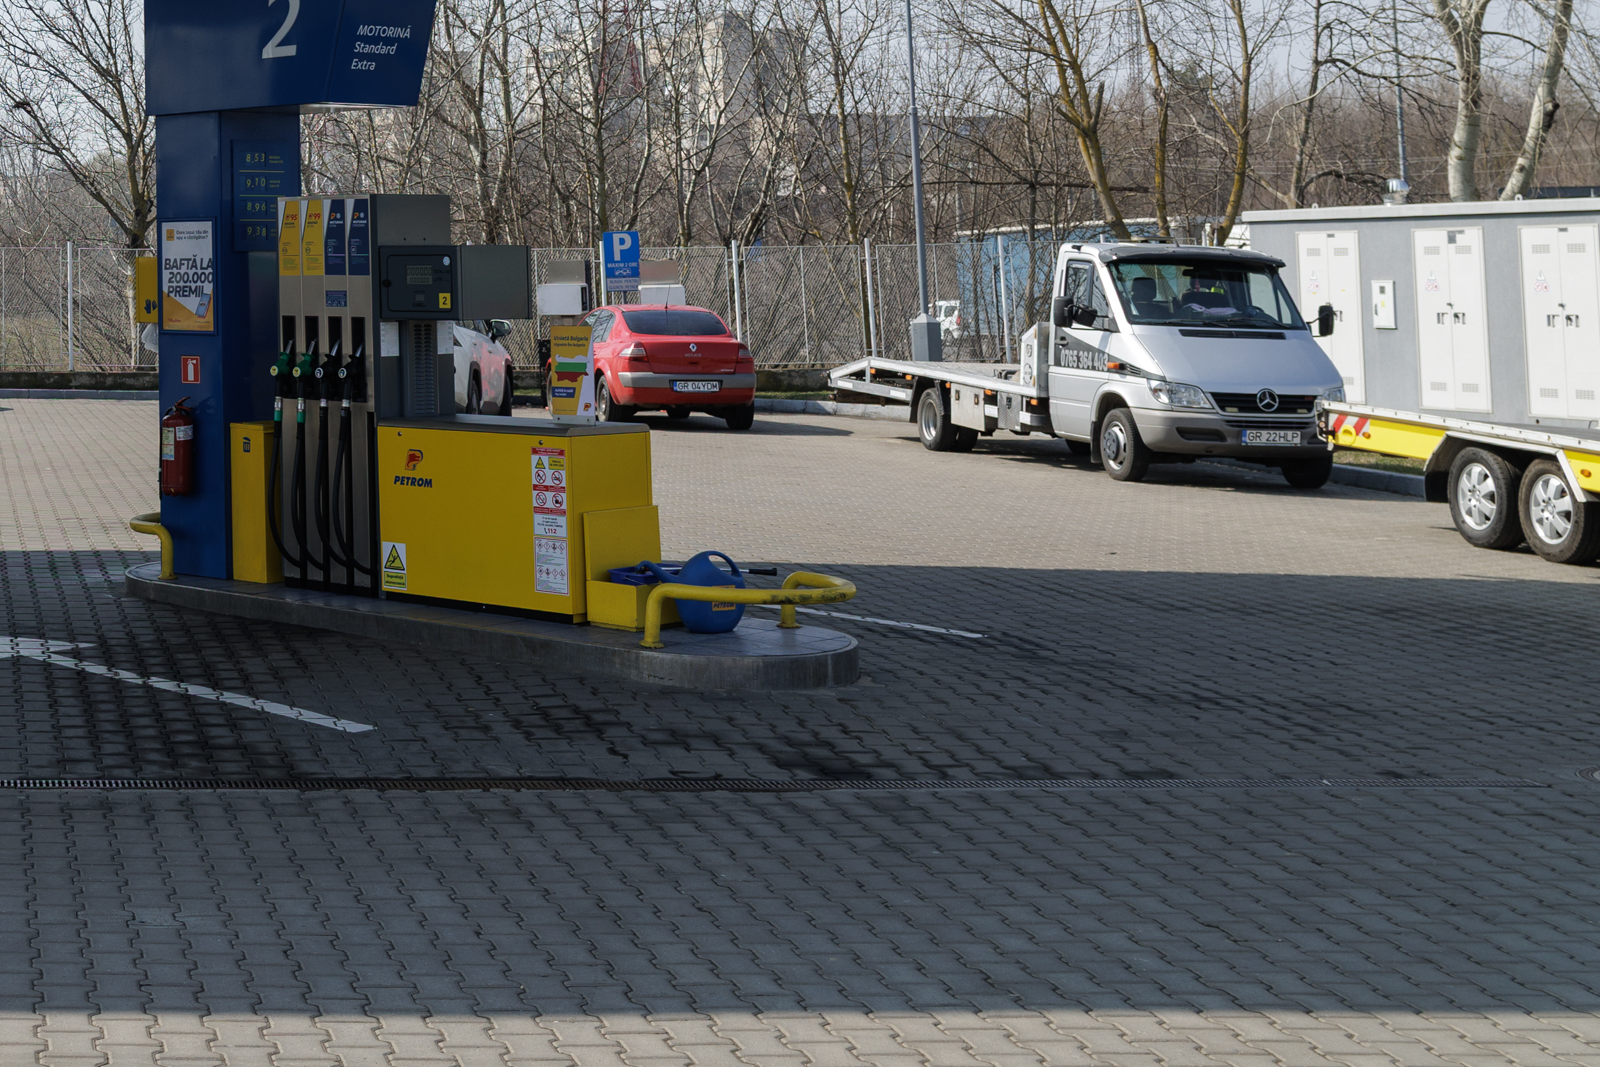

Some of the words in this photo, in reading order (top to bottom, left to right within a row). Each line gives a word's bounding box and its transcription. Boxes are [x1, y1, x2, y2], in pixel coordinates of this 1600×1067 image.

[357, 25, 412, 39] MOTORINĂ
[354, 41, 398, 55] Standard
[351, 59, 376, 71] Extra
[246, 153, 266, 164] 8.53
[246, 178, 266, 188] 9.10
[247, 202, 266, 212] 8.96
[247, 227, 267, 237] 9.38
[612, 233, 633, 262] P
[164, 254, 198, 270] BAFTĂ
[200, 258, 213, 270] LA
[168, 272, 213, 284] 200.000
[442, 296, 448, 305] 2
[1061, 349, 1078, 367] 0765
[1078, 350, 1092, 369] 364
[1094, 352, 1109, 372] 403
[691, 382, 718, 390] 04YDM
[1247, 431, 1262, 442] GR
[1266, 432, 1299, 443] 22HLP
[393, 475, 433, 488] PETROM
